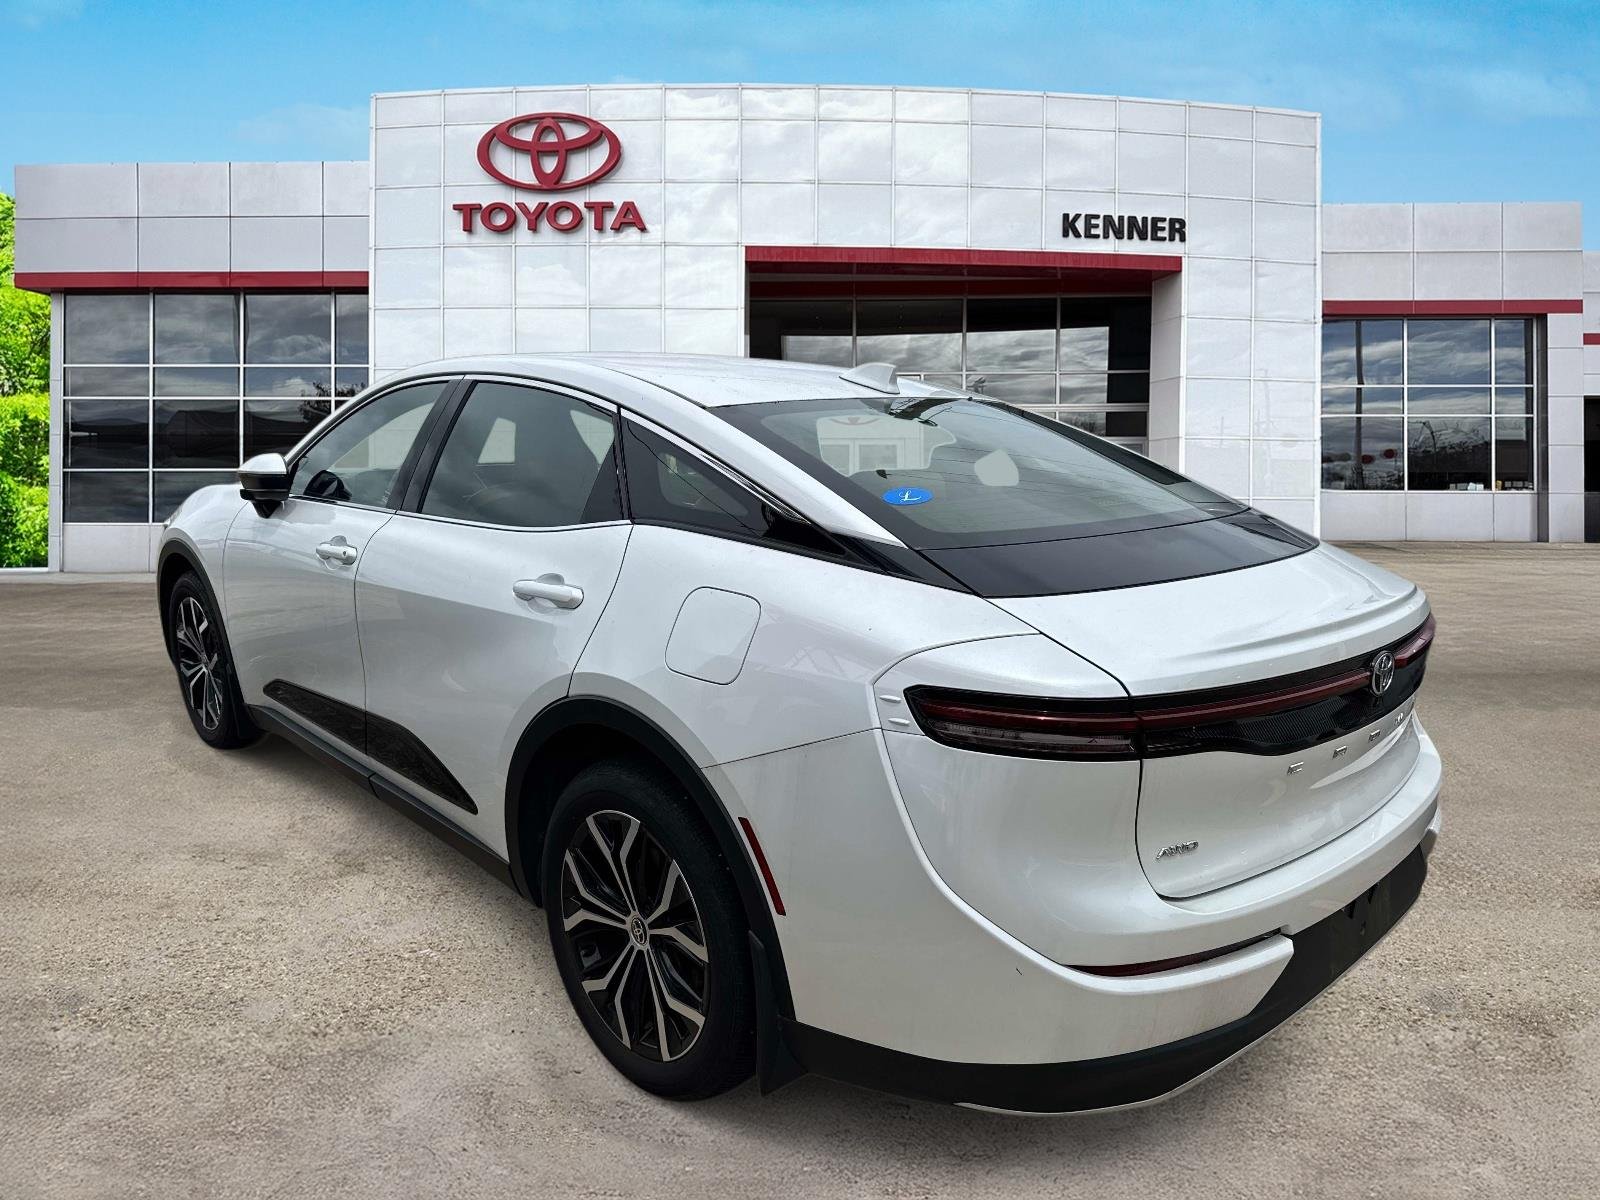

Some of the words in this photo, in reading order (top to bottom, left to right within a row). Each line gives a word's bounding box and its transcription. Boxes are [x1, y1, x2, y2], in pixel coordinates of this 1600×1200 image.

[453, 201, 647, 233] TOYOTA
[1062, 213, 1187, 242] KENNER
[1156, 840, 1199, 860] AWD
